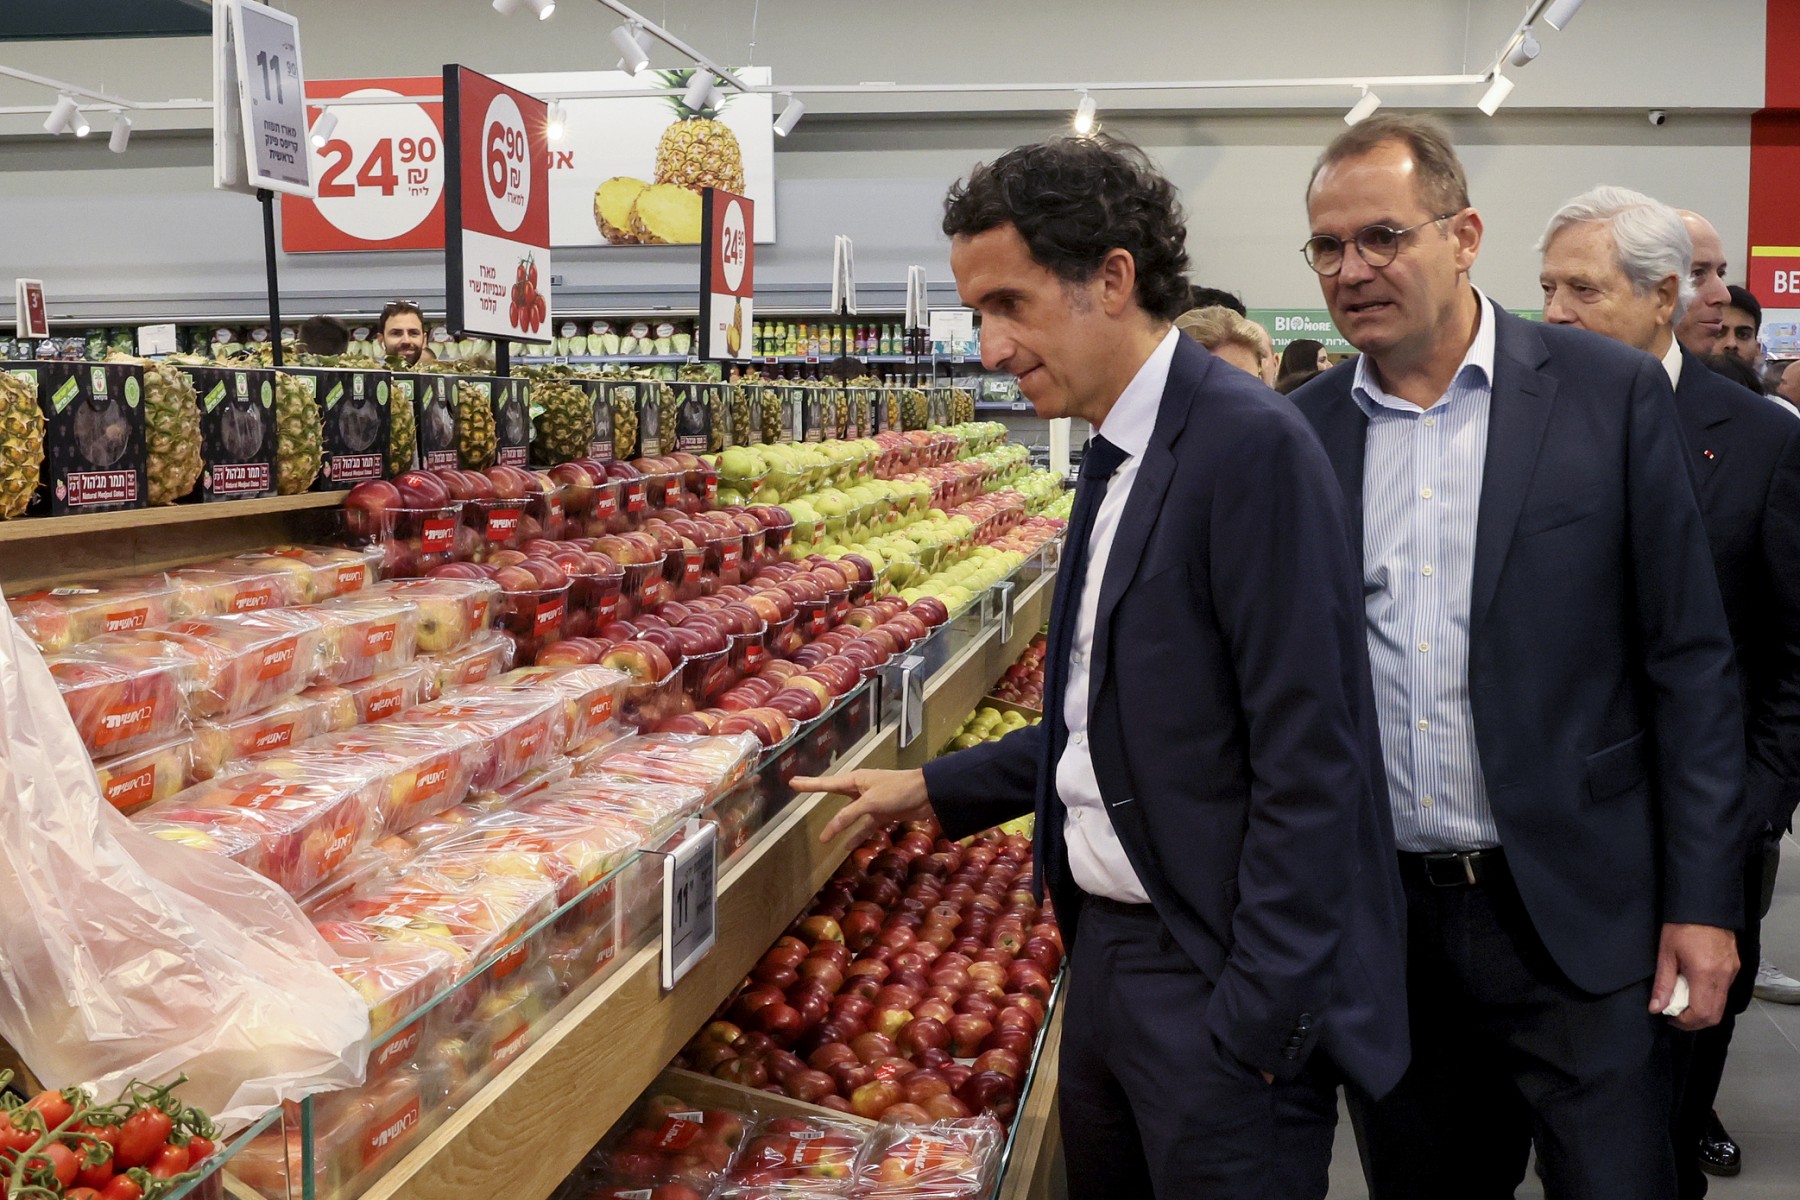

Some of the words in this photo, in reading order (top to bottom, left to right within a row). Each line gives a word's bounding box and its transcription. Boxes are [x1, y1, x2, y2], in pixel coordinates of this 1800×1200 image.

[256, 50, 284, 105] 11
[316, 138, 399, 198] 24
[398, 136, 436, 163] 90
[486, 120, 508, 199] 6
[506, 126, 524, 163] 90
[724, 226, 738, 265] 24
[469, 279, 482, 293] שרי
[479, 264, 496, 280] מארז
[482, 281, 507, 298] עגבניות
[1275, 316, 1304, 331] BIO
[1304, 322, 1331, 332] MORE
[676, 882, 689, 928] 11
